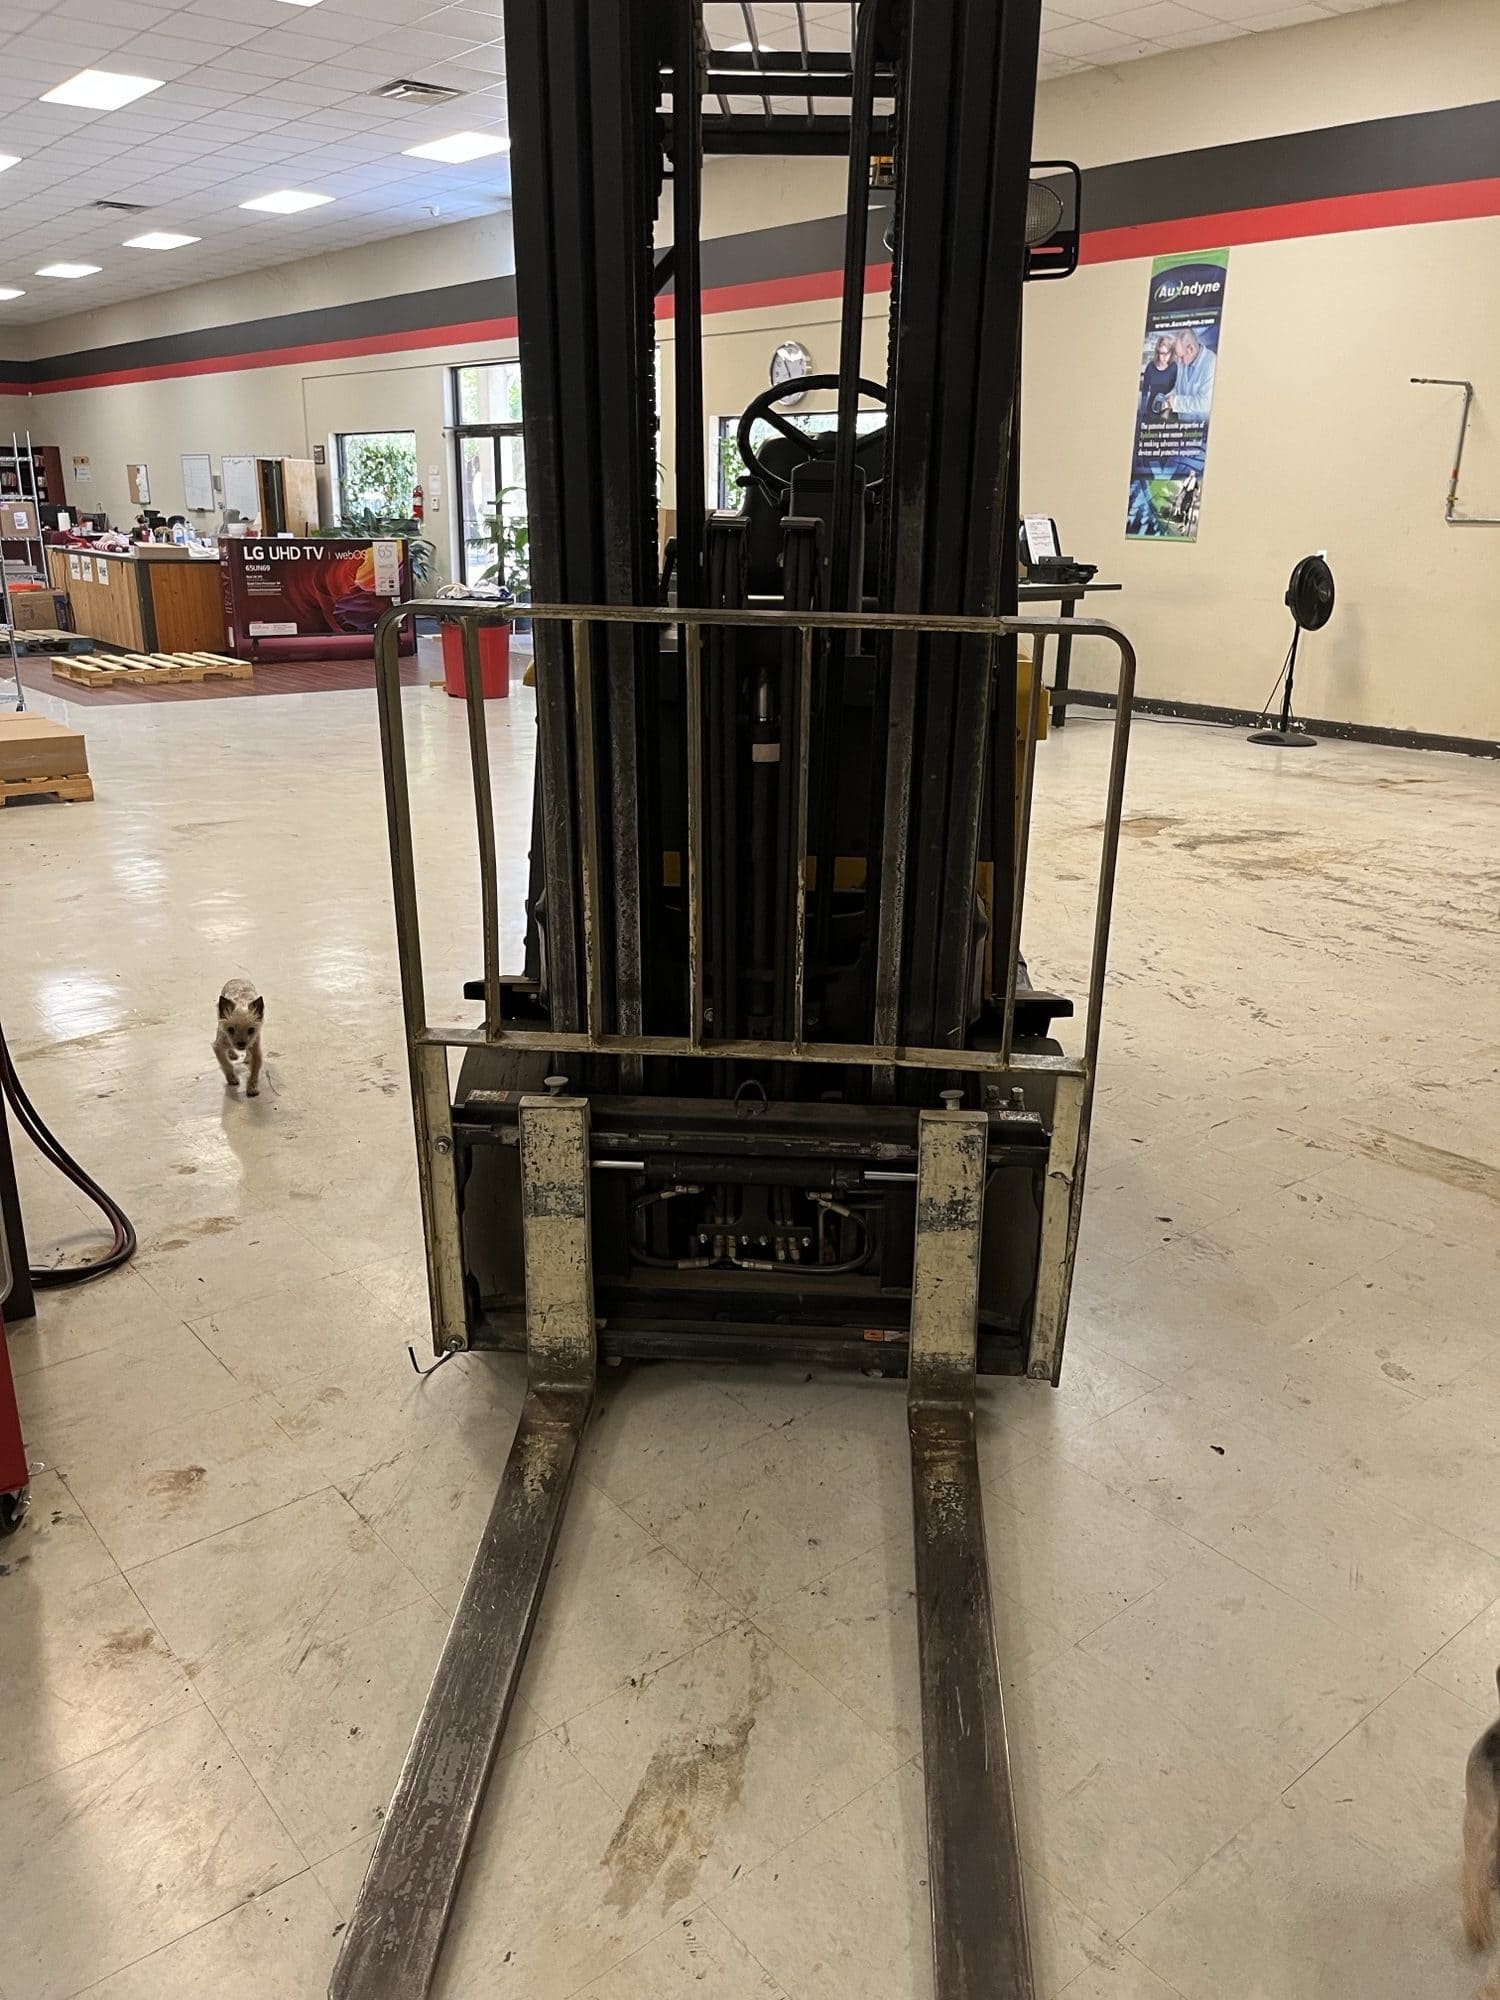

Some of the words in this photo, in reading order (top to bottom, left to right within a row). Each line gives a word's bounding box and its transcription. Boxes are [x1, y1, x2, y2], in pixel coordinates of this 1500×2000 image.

[1158, 280, 1221, 298] Auxadyne
[243, 545, 265, 561] LG
[268, 545, 301, 561] UHD
[302, 545, 324, 561] TV
[334, 549, 368, 561] webOS
[244, 564, 271, 572] 65UN69
